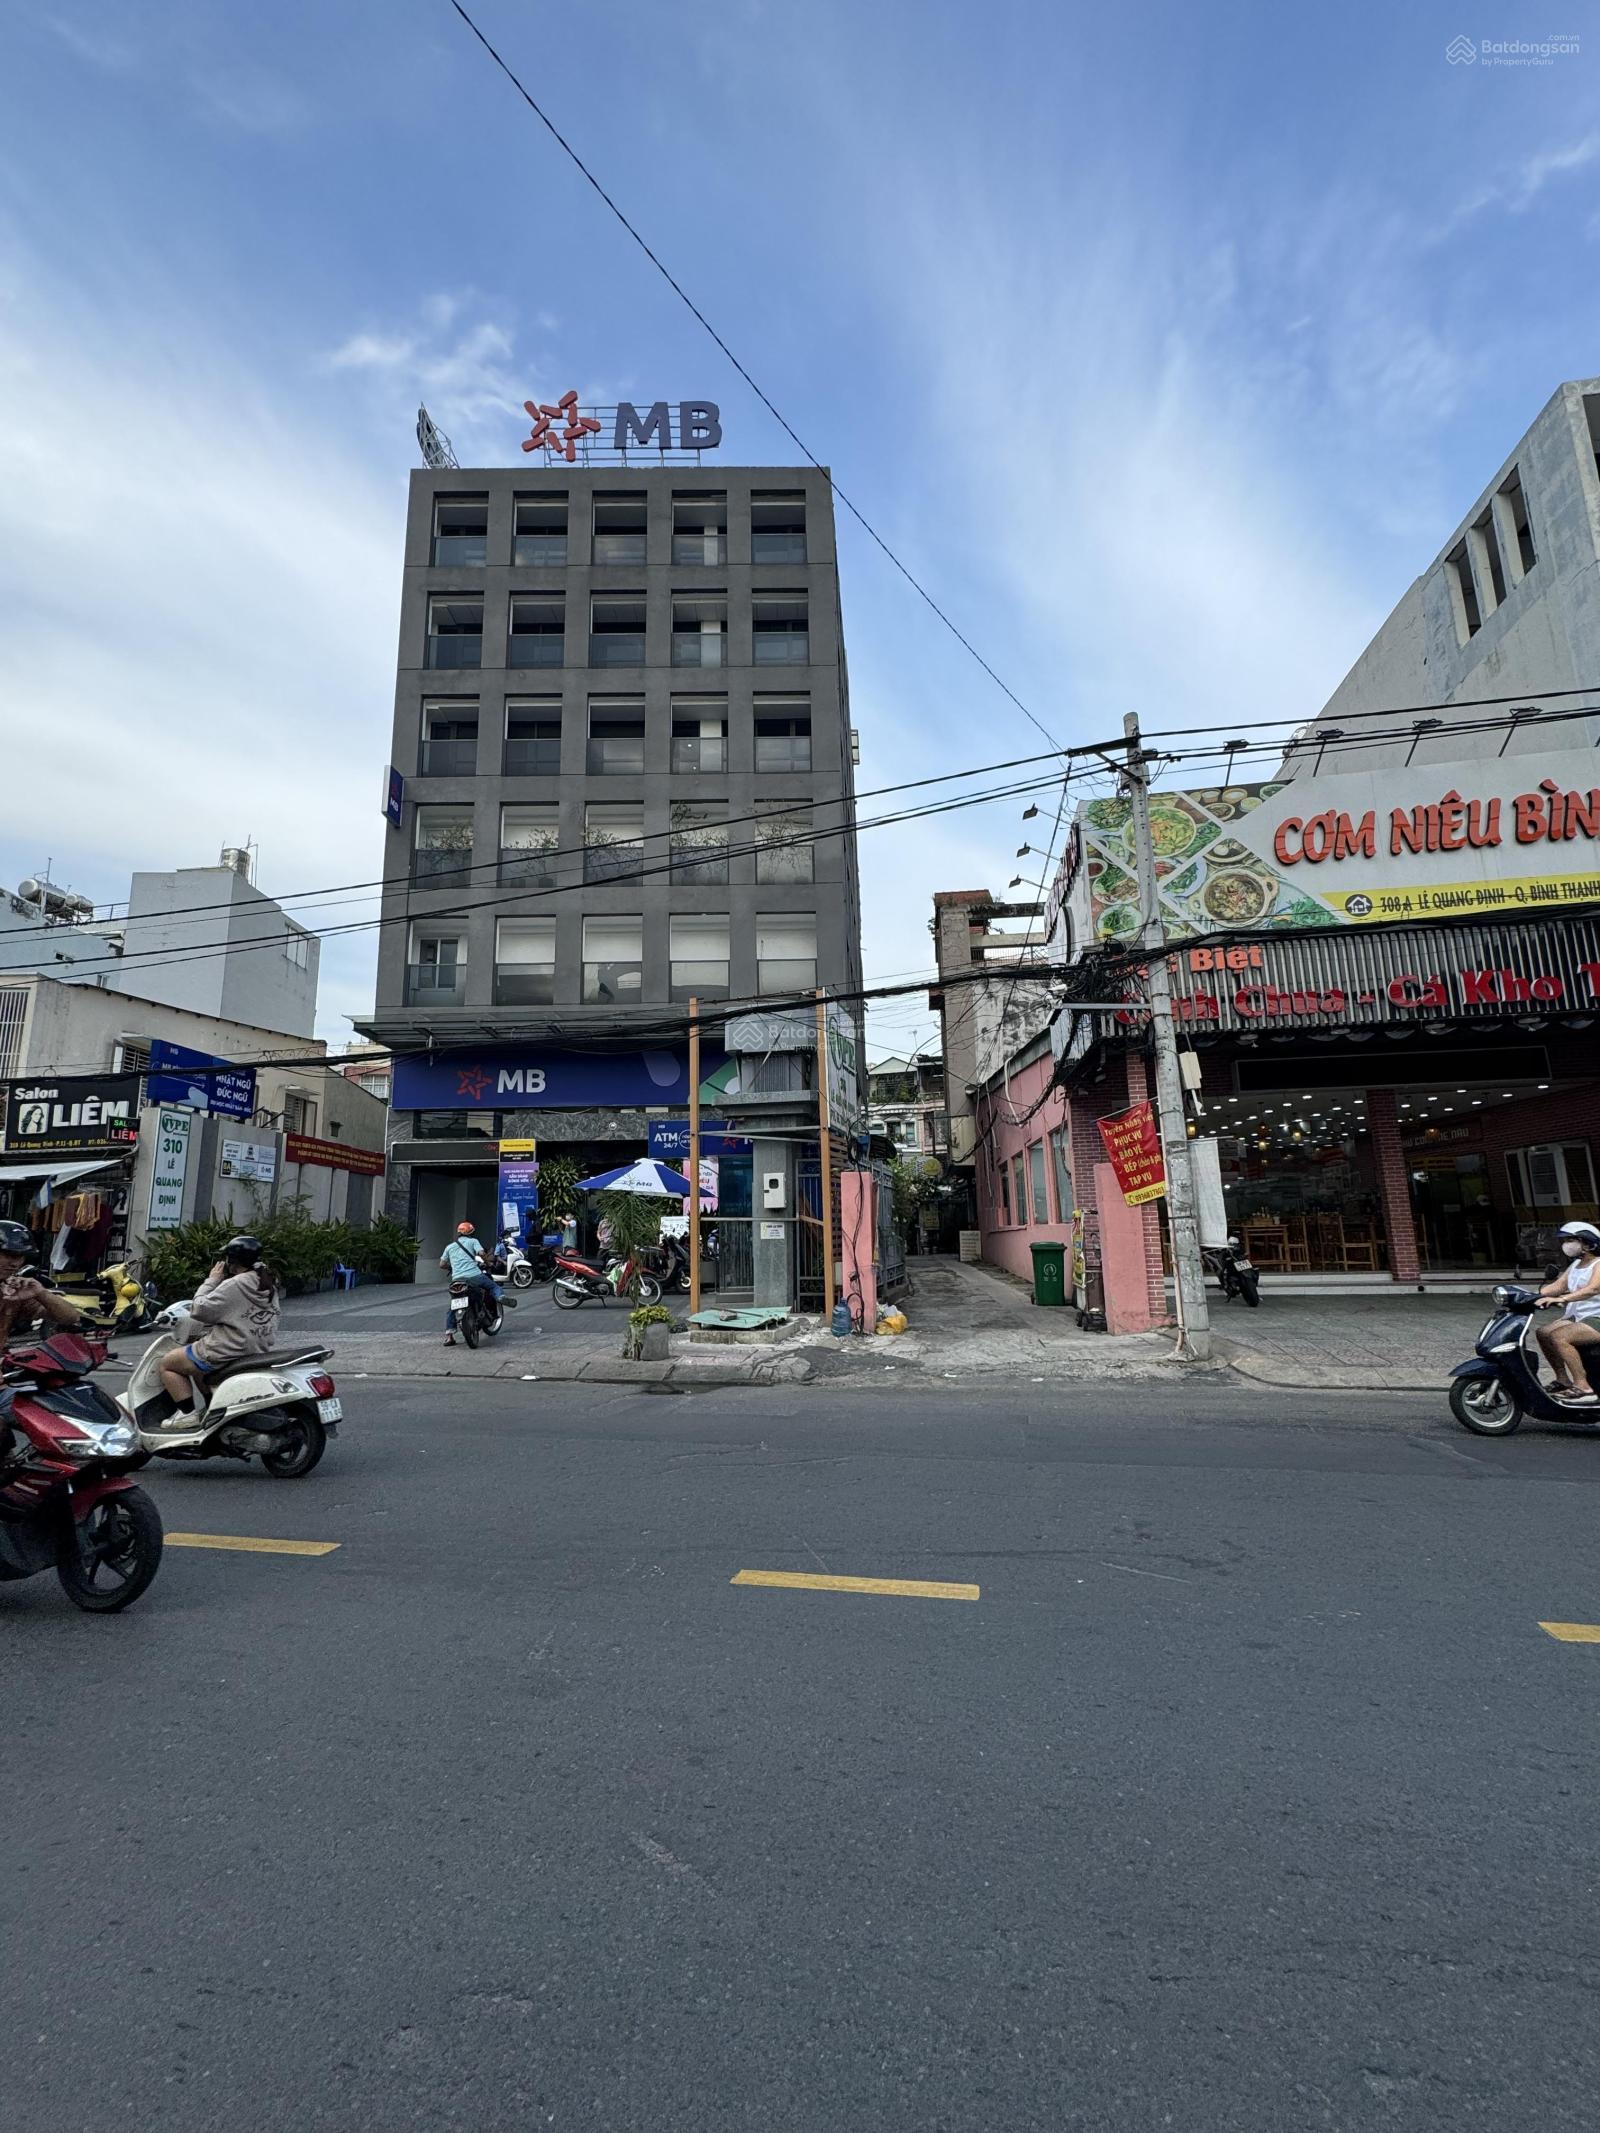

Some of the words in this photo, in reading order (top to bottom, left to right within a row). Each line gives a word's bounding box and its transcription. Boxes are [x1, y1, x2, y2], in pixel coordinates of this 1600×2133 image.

[614, 400, 723, 449] MB
[1274, 809, 1376, 865] CƠM
[1390, 789, 1502, 856] NIÊU
[1417, 890, 1430, 910] LÊ
[1432, 889, 1474, 910] QUANG
[1530, 881, 1559, 902] BÌNH
[1189, 945, 1263, 974] Biệt
[1233, 984, 1346, 1018] Chua
[1387, 974, 1449, 1008] Cá
[1458, 969, 1564, 1006] Kho
[497, 1068, 546, 1094] MB
[14, 1087, 59, 1100] Salon
[52, 1096, 130, 1127] LIÊM
[163, 1138, 183, 1154] 310
[654, 1133, 678, 1142] ATM
[167, 1158, 175, 1169] LÊ
[1124, 1159, 1137, 1173] BẾP
[155, 1177, 182, 1188] QUANG
[158, 1194, 176, 1207] ĐỊNH
